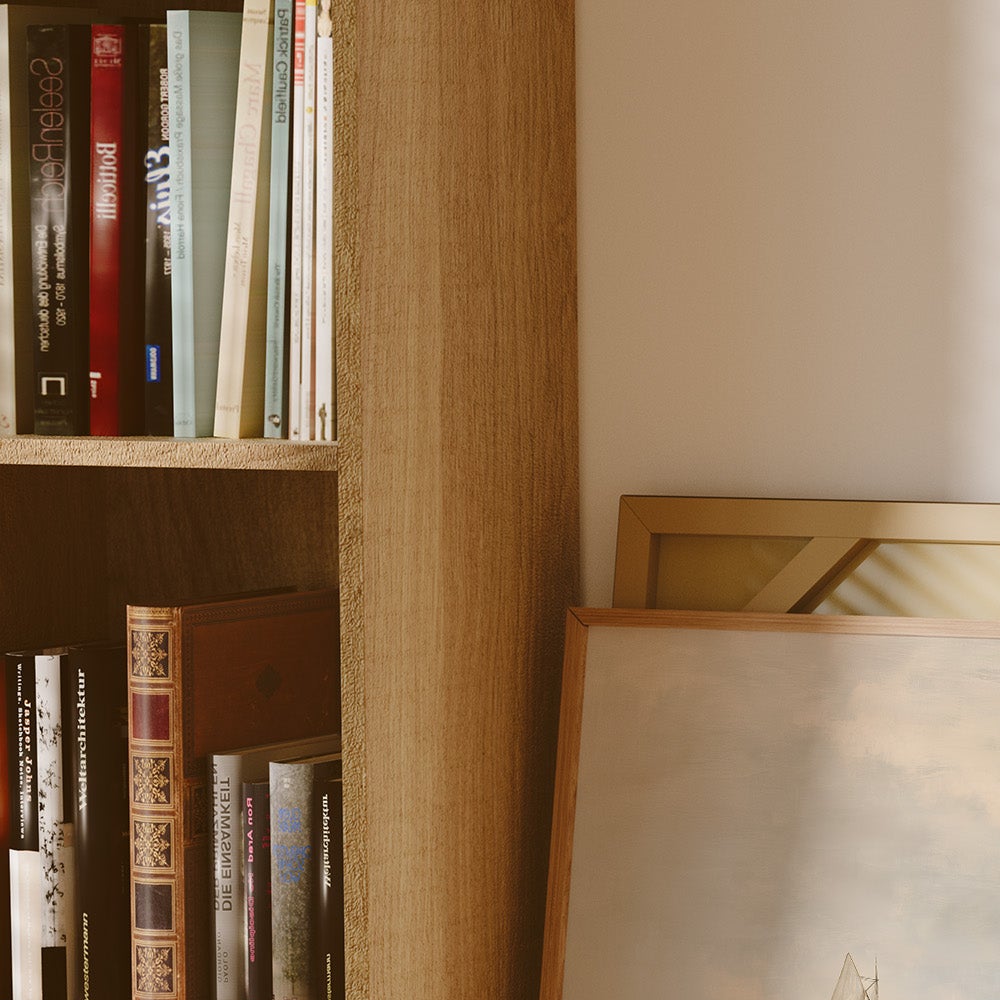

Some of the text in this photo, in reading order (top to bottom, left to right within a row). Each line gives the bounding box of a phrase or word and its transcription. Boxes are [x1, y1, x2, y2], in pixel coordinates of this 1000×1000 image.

[24, 700, 33, 802] Jasper Johns
[77, 668, 87, 811] Weltarchitektur
